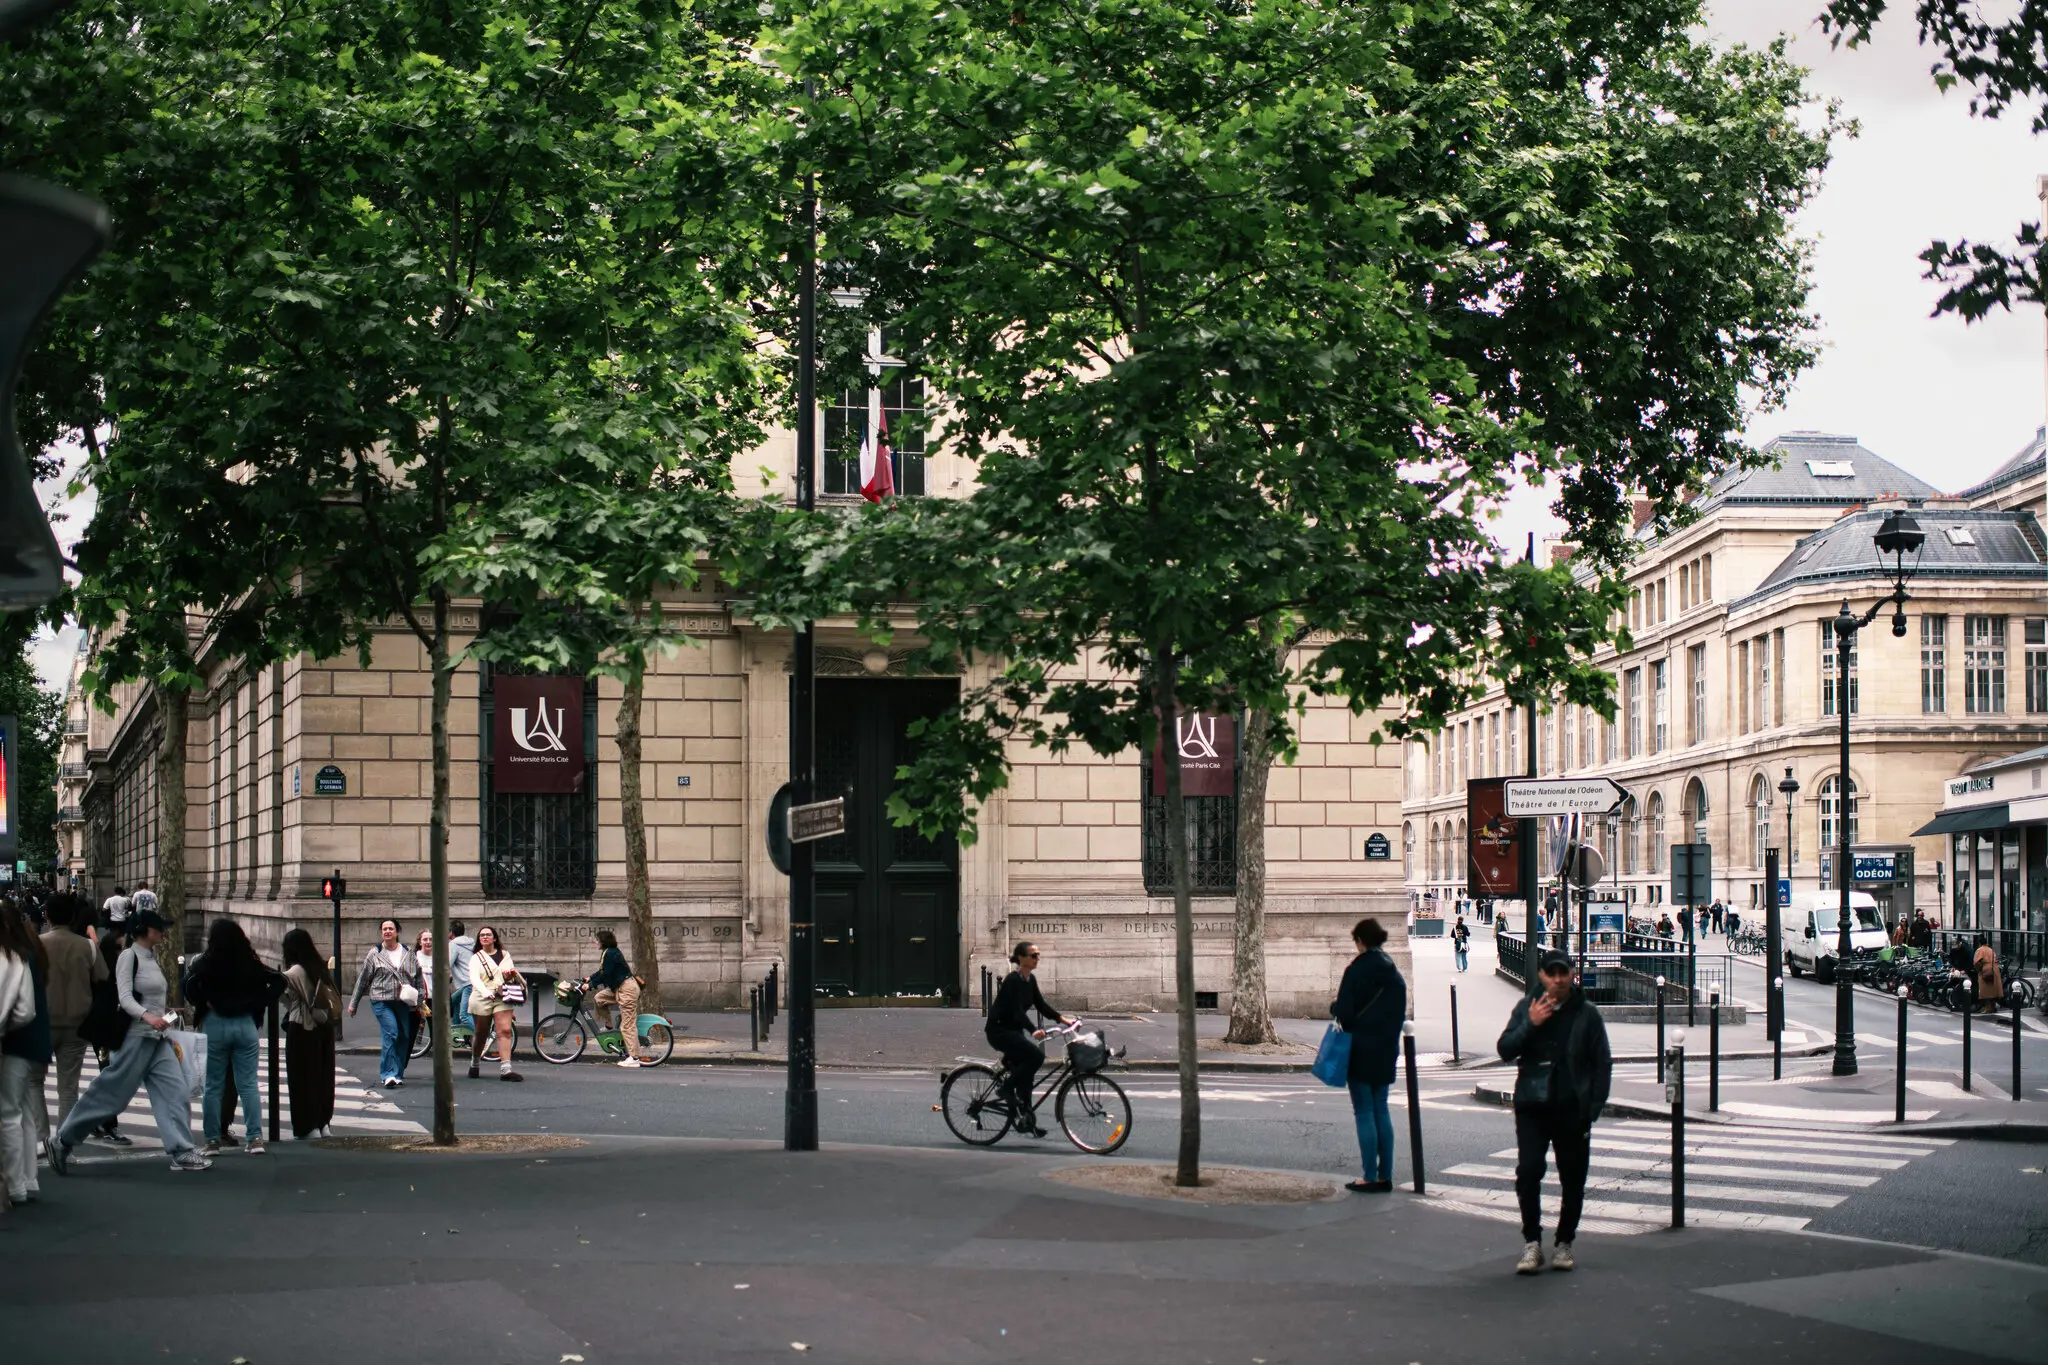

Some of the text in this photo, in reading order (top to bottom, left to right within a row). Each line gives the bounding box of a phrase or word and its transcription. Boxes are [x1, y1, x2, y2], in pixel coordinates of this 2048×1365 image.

[509, 755, 540, 763] Université
[679, 777, 689, 785] 85
[1511, 788, 1537, 796] Théâtre
[1538, 787, 1567, 795] National
[1567, 786, 1577, 794] de
[1511, 800, 1543, 809] Théâtre
[1547, 800, 1557, 808] de
[1856, 868, 1892, 878] ODÉON
[682, 926, 700, 937] DU
[1018, 922, 1068, 934] JUILLET
[1079, 923, 1104, 933] 1881
